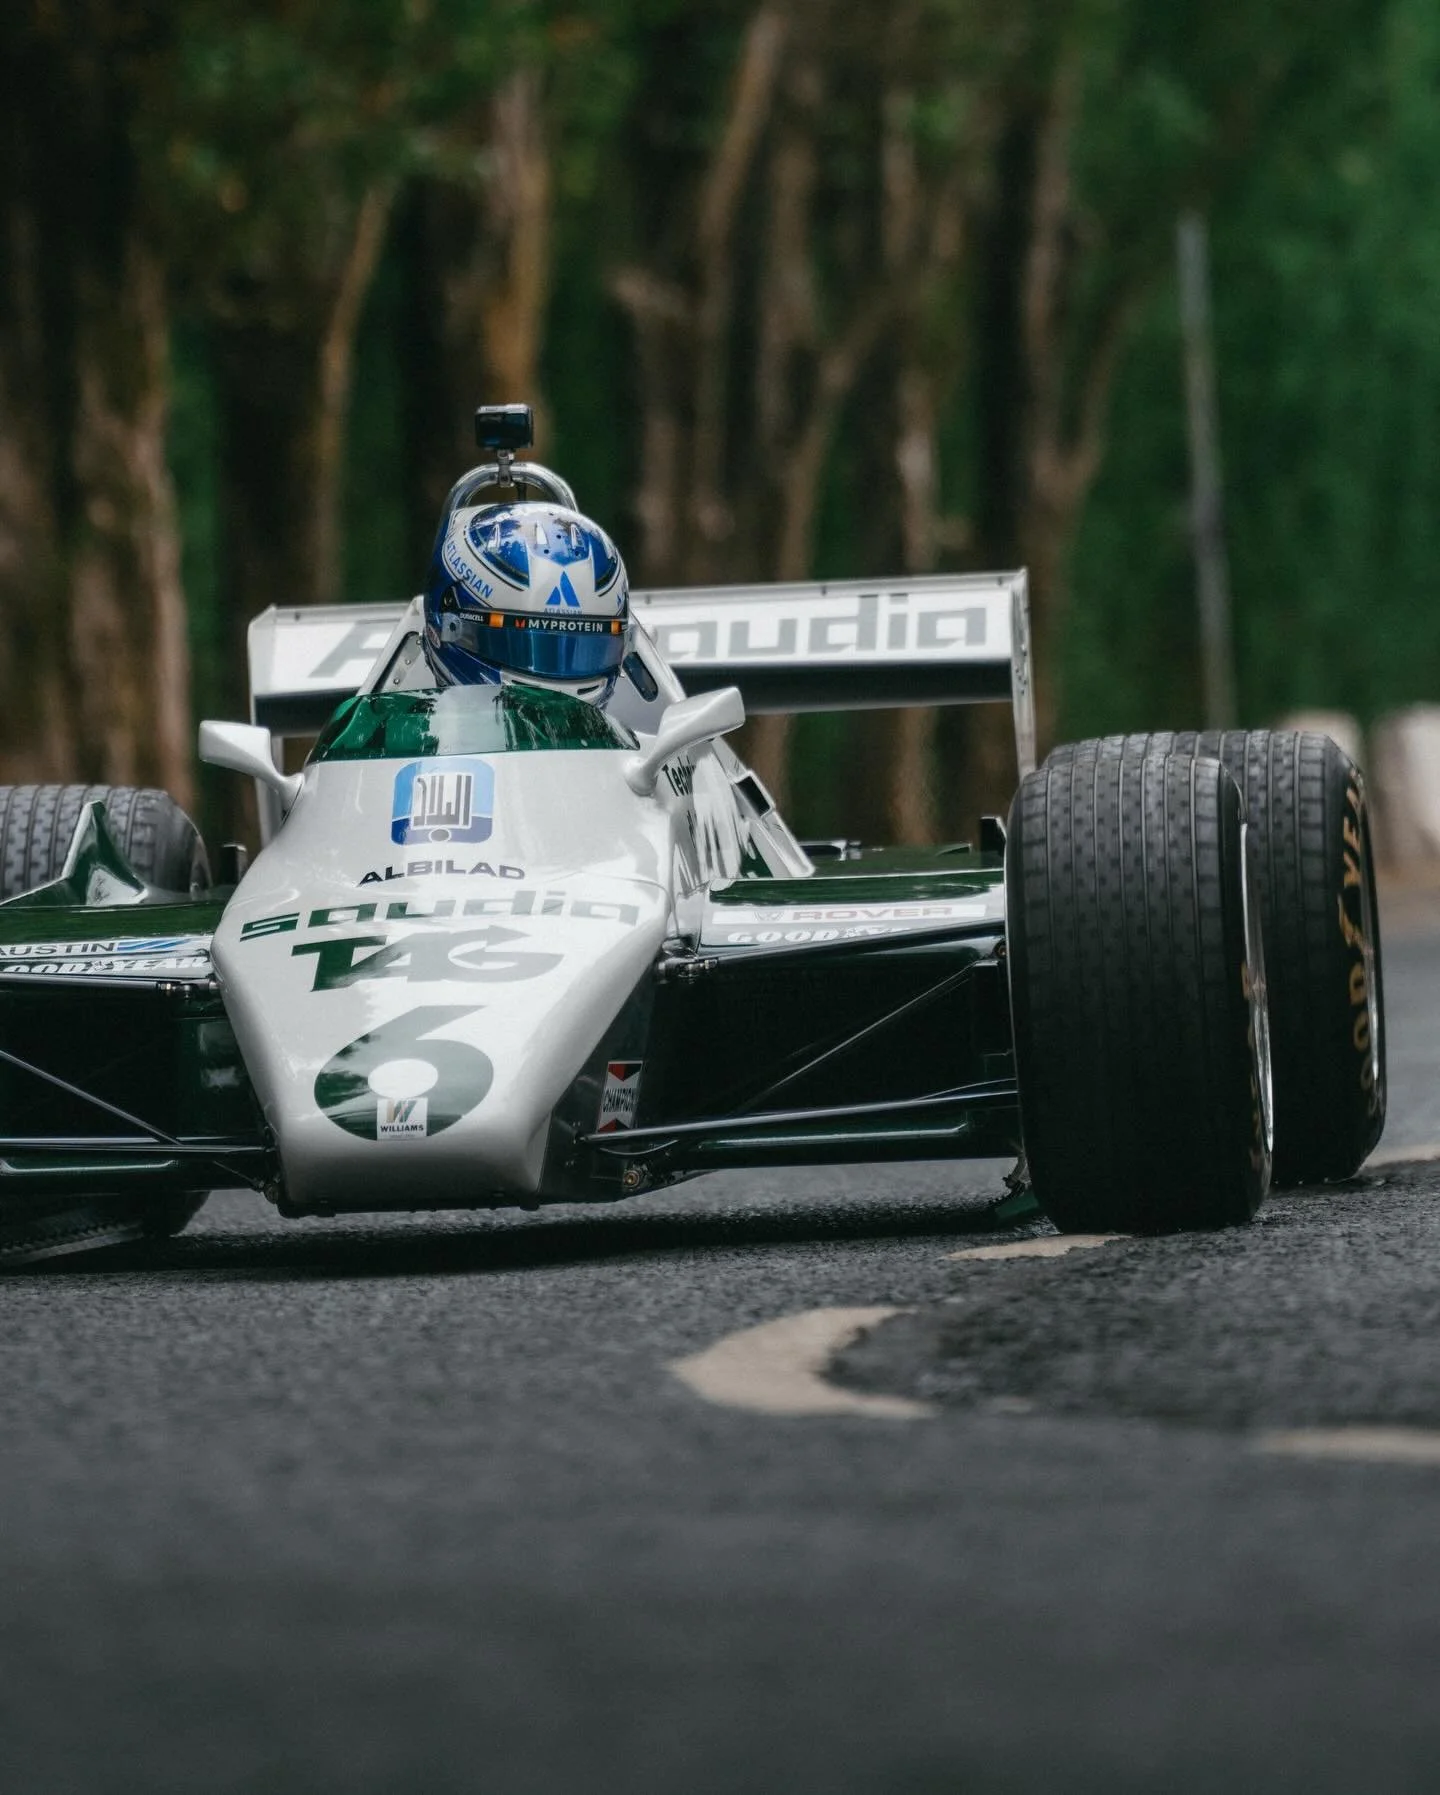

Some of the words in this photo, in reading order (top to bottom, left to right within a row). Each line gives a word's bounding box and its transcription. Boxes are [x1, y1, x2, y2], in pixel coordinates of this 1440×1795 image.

[528, 620, 603, 632] MYPROTEIN
[655, 593, 987, 660] audia
[357, 860, 525, 887] ALBILAD
[240, 890, 640, 942] saudia
[792, 906, 953, 922] ROVER
[2, 956, 212, 974] OODYEAR
[291, 924, 565, 992] TAG
[313, 1005, 494, 1141] 6
[380, 1124, 424, 1132] WILLIAMS
